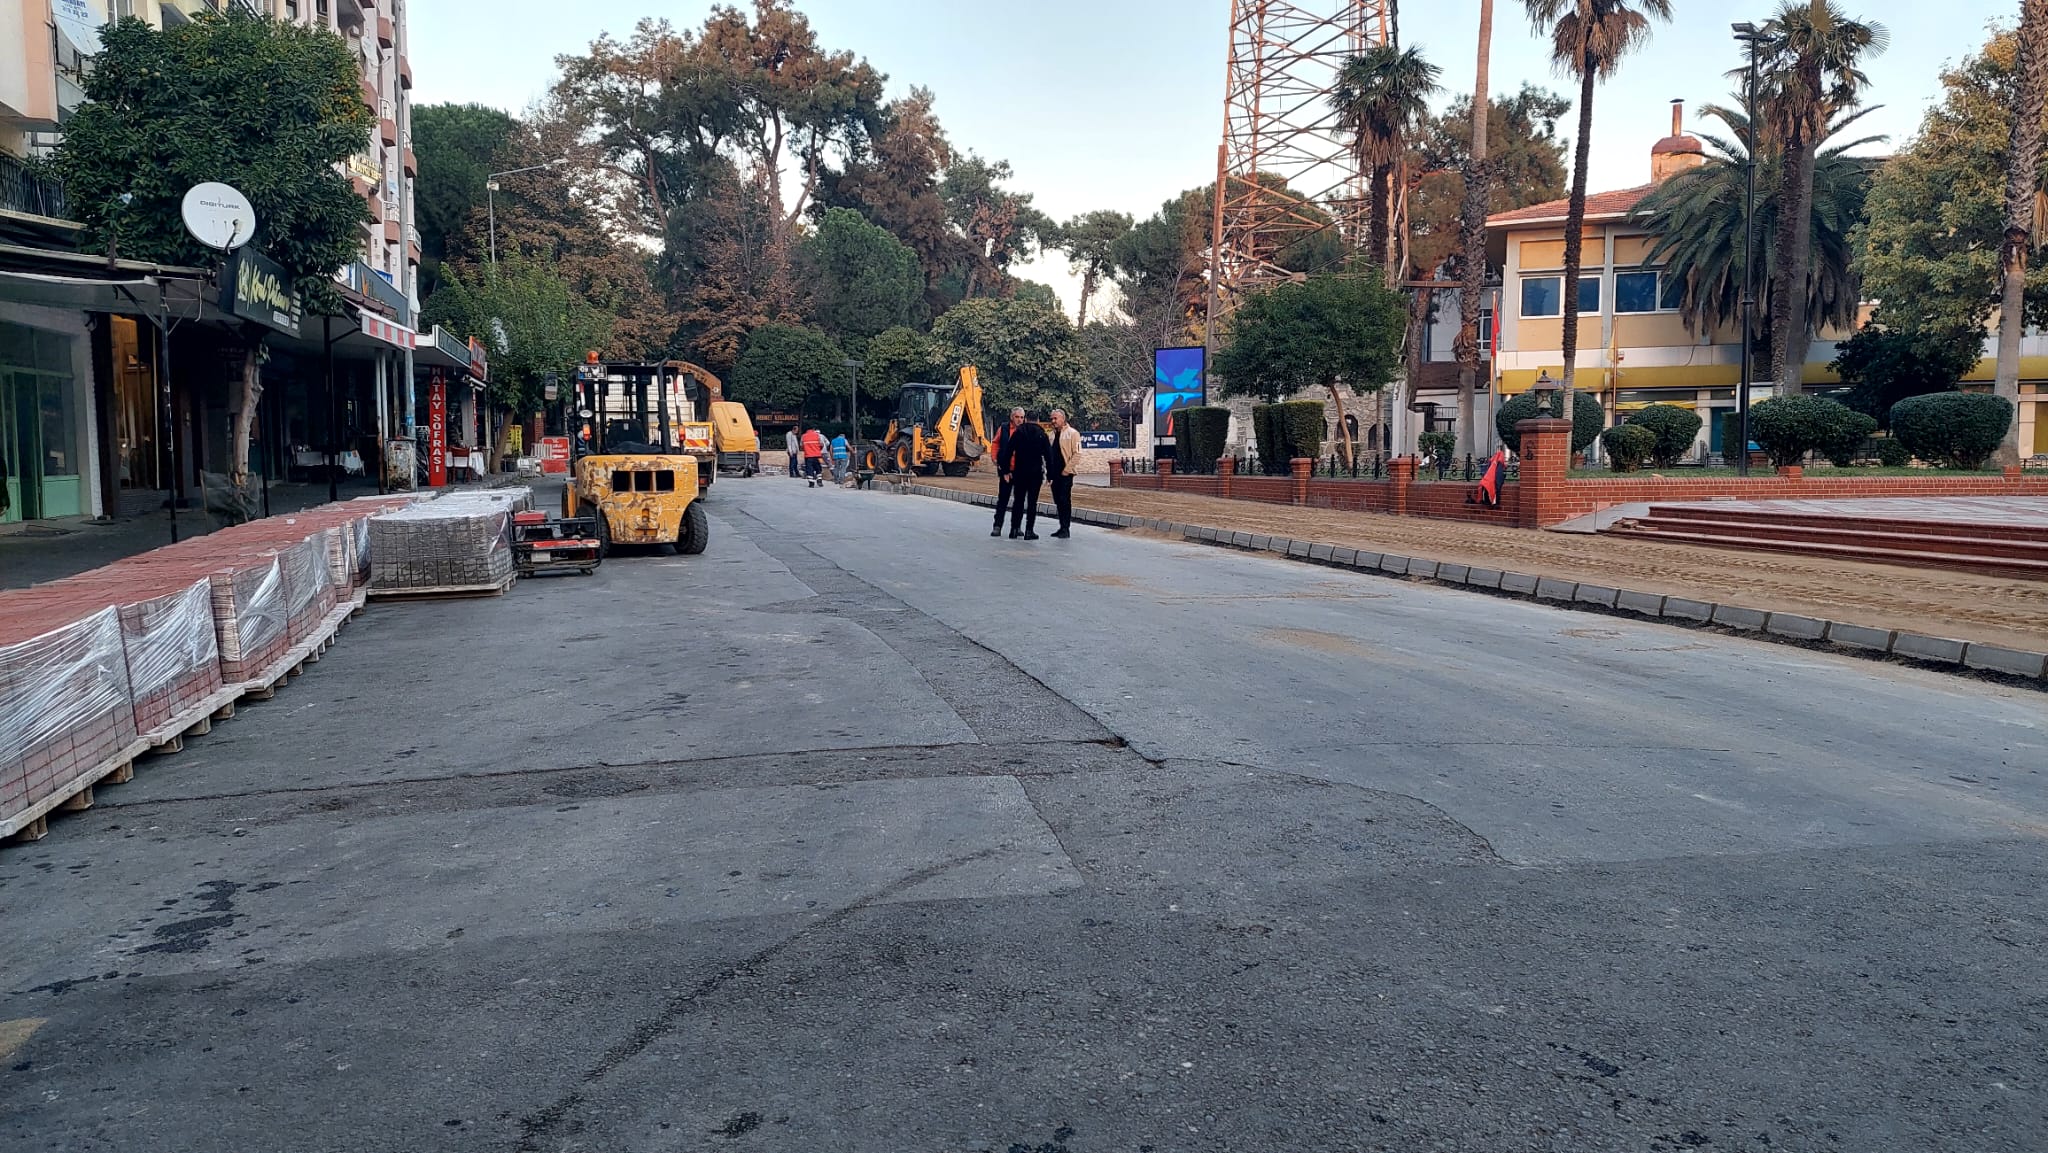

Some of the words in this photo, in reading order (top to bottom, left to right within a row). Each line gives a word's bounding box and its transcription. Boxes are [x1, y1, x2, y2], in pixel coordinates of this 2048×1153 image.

[431, 367, 441, 410] HATAY
[949, 405, 962, 432] JCB
[432, 413, 441, 473] SOFRASI
